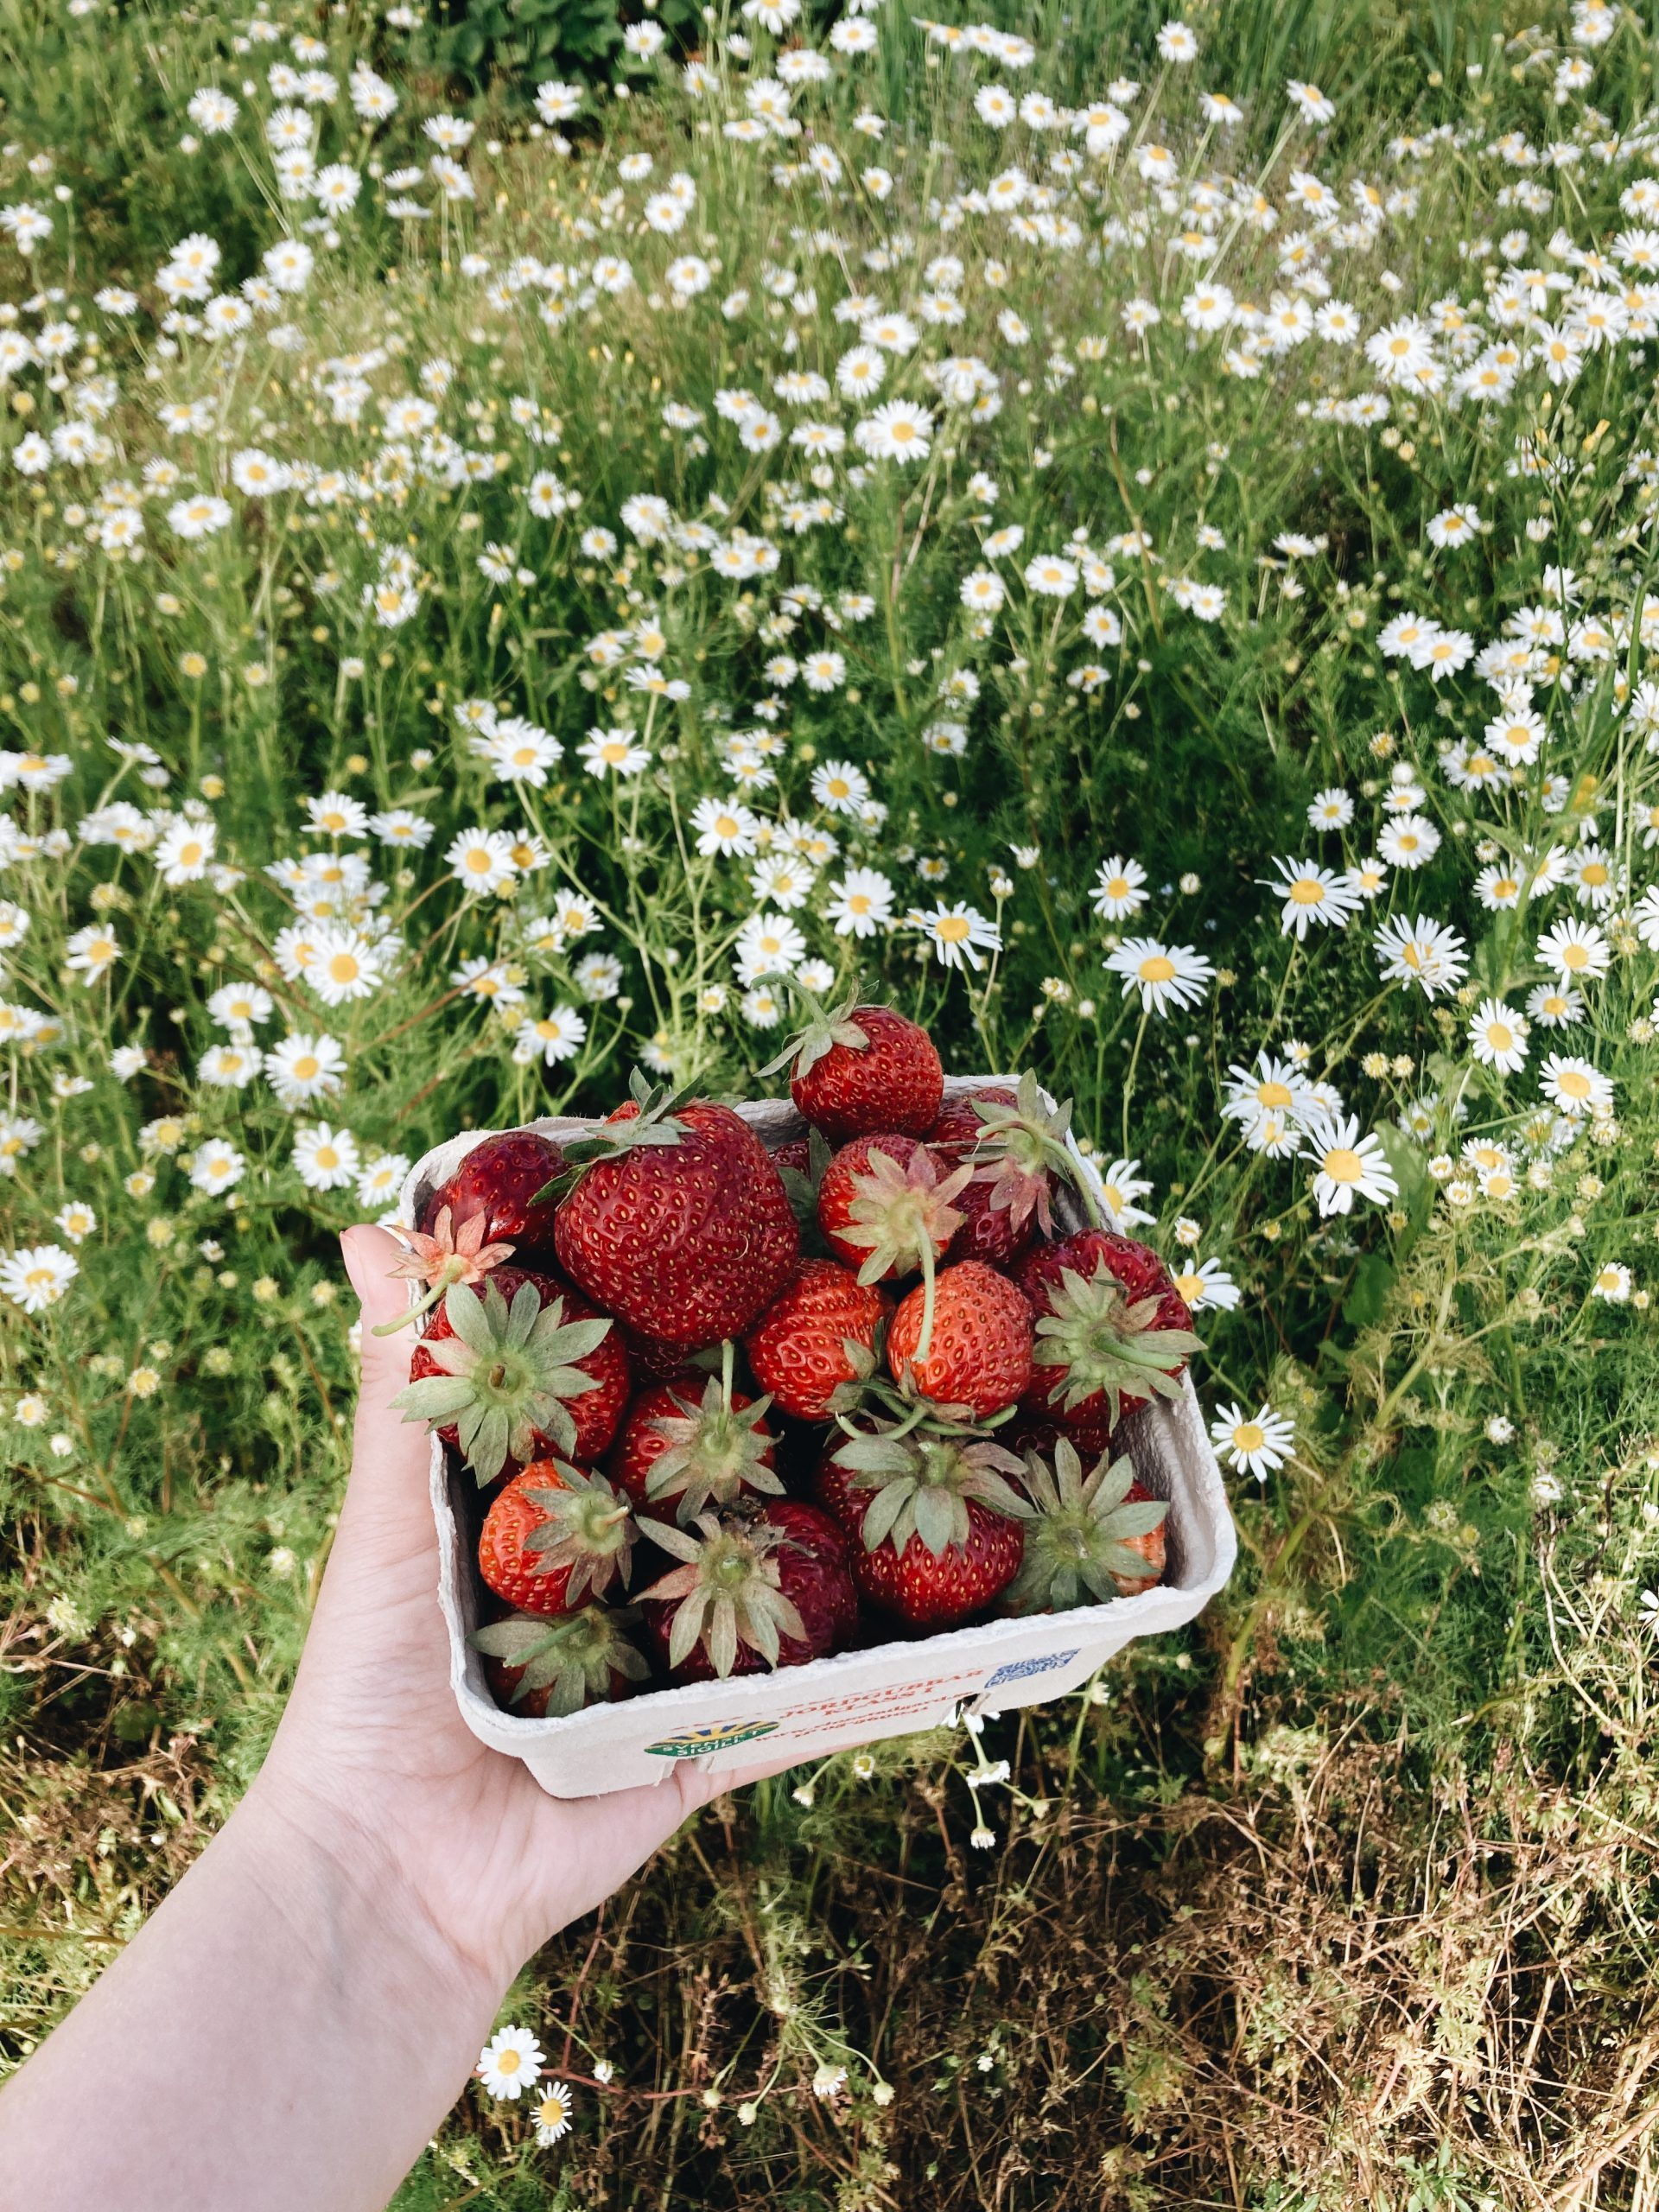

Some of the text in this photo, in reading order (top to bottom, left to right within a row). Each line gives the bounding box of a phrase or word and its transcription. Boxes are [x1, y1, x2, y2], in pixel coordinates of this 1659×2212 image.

[779, 1669, 984, 1719] JORDGUBBAR
[823, 1690, 916, 1716] KLASS
[677, 1736, 744, 1757] SIGILL
